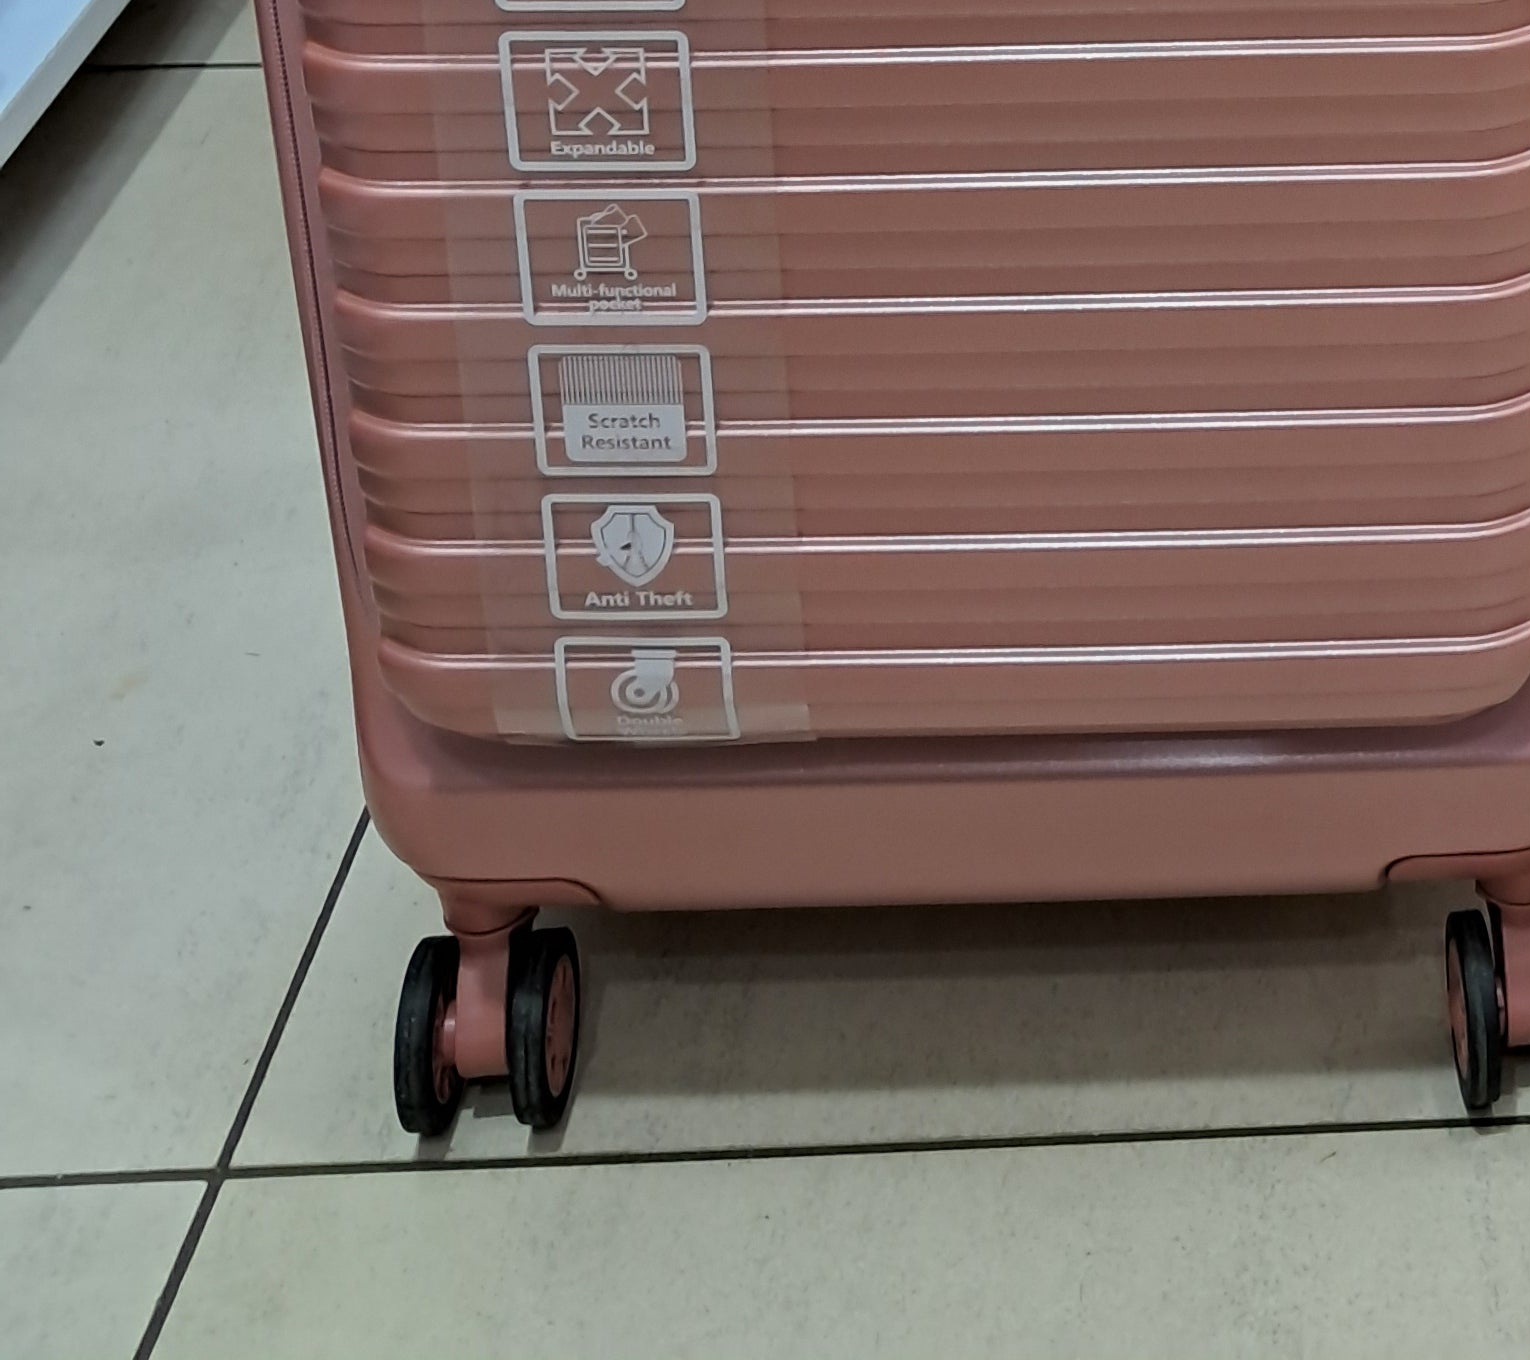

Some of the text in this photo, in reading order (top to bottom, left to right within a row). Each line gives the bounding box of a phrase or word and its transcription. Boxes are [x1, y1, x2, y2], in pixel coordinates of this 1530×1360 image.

[550, 140, 656, 158] Expandable
[551, 282, 677, 299] Multi-functional
[588, 296, 643, 316] pocket
[587, 412, 661, 429] Scratch
[581, 434, 672, 450] Resistant
[584, 590, 694, 608] Anti Theft
